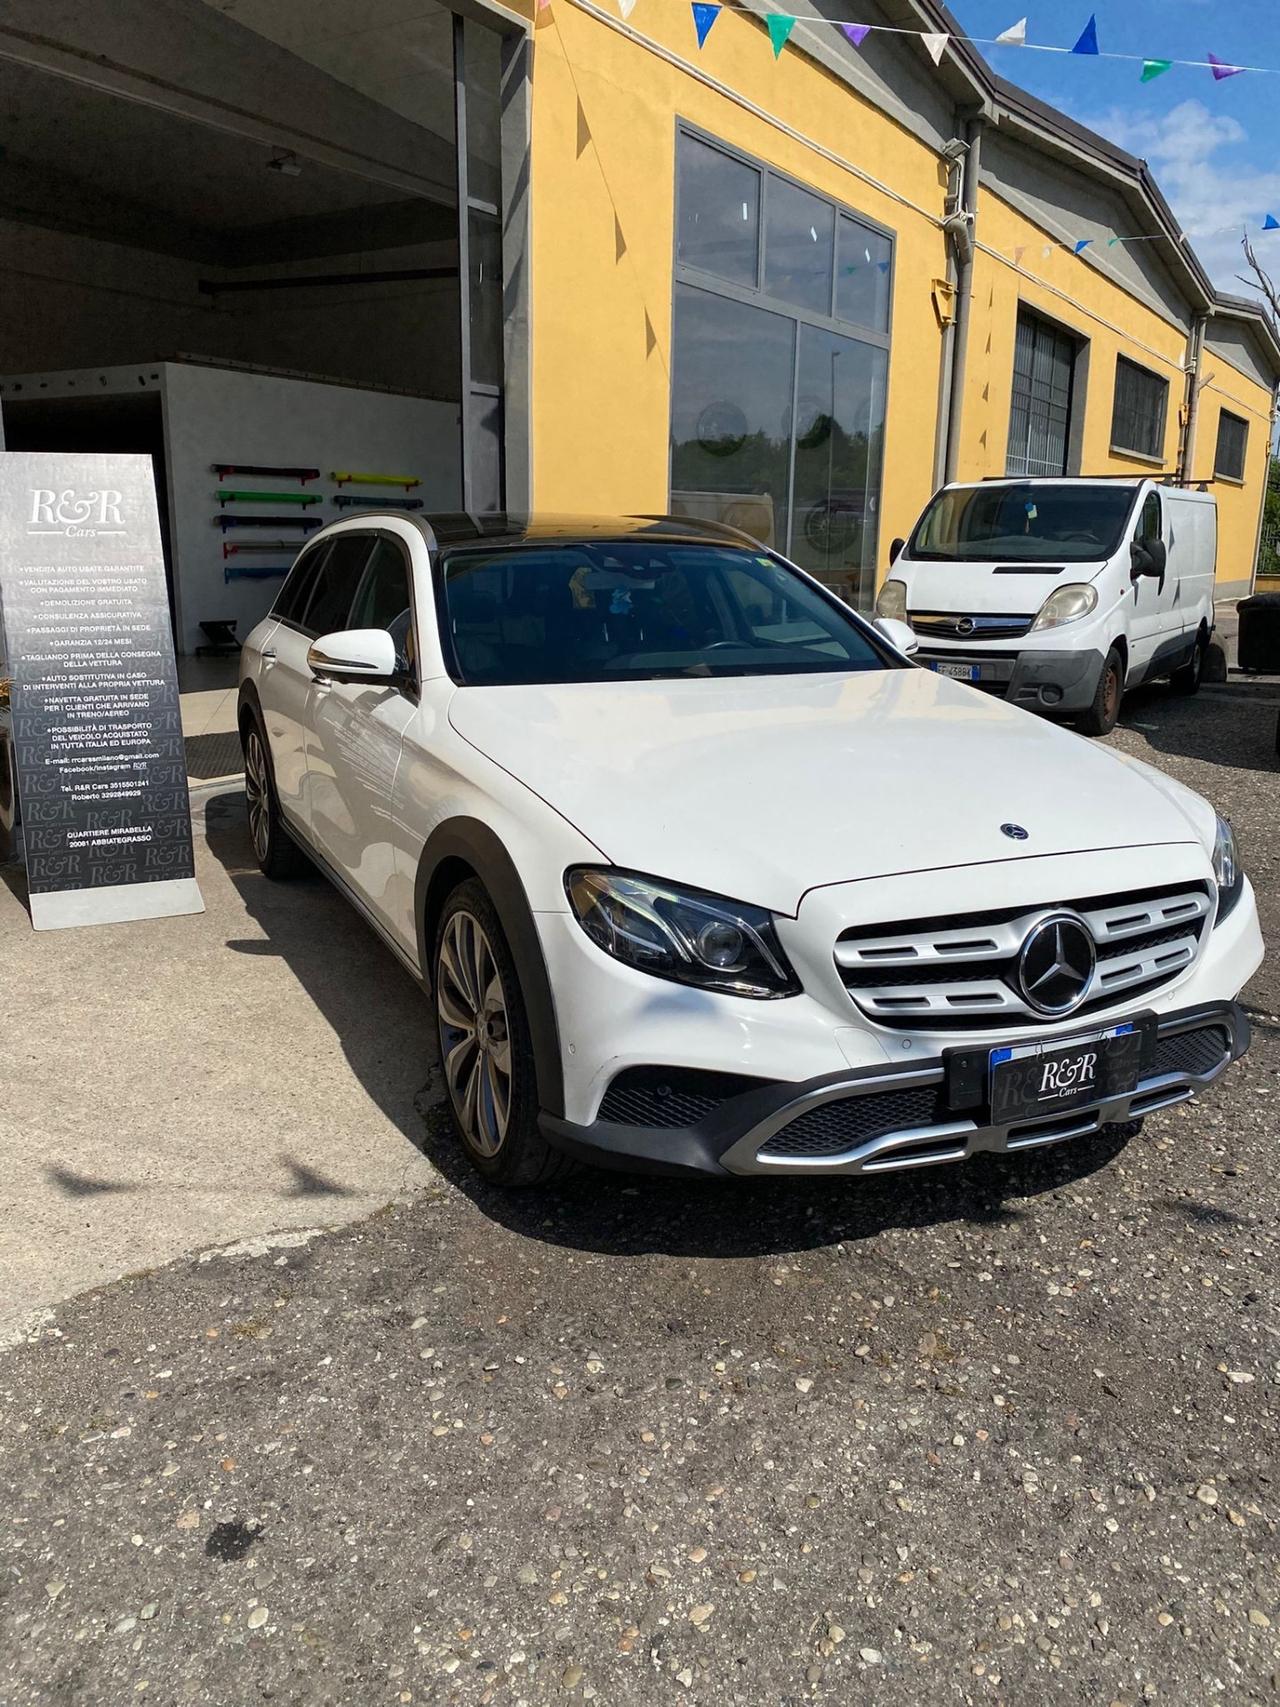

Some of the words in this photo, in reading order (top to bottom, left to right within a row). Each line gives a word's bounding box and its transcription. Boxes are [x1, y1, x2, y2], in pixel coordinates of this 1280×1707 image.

[27, 488, 126, 525] R&R
[65, 525, 97, 538] Cars
[57, 565, 78, 573] AUTO
[76, 578, 91, 586] DEL
[92, 578, 122, 586] VOSTRO
[123, 577, 148, 585] USATO
[49, 586, 96, 594] PAGAMENTO
[44, 599, 96, 607] DEMOLIZIONE
[97, 598, 133, 606] GRATUITA
[38, 612, 90, 620] CONSULENZA
[90, 611, 142, 619] ASSICURATIVA
[31, 626, 68, 634] PASSAGGI
[79, 623, 122, 633] PROPRIETÀ
[131, 624, 152, 632] SEDE
[54, 639, 93, 647] GARANZIA
[113, 638, 132, 646] MESI
[26, 653, 69, 661] TAGLIANDO
[70, 652, 95, 661] PRIMA
[96, 651, 120, 660] DELLA
[121, 650, 162, 659] CONSEGNA
[63, 660, 88, 668] DELLA
[88, 659, 123, 668] VETTURA
[46, 674, 68, 682] AUTO
[69, 672, 116, 682] SOSTITUTIVA
[116, 672, 125, 680] IN
[126, 671, 148, 680] CASO
[23, 683, 31, 691] DI
[32, 682, 77, 691] INTERVENTI
[78, 681, 98, 690] ALLA
[98, 680, 131, 689] PROPRIA
[131, 678, 166, 687] VETTURA
[48, 695, 82, 704] NAVETTA
[83, 694, 119, 702] GRATUITA
[119, 693, 129, 701] IN
[129, 693, 150, 701] SEDE
[44, 704, 61, 712] PER
[65, 702, 95, 712] CLIENTI
[95, 702, 112, 710] CHE
[112, 701, 150, 709] ARRIVANO
[66, 711, 76, 719] IN
[76, 709, 130, 719] TRENO/AEREO
[51, 723, 98, 734] POSSIBILITÀ
[98, 725, 108, 733] DI
[107, 722, 153, 731] TRASPORTO
[52, 734, 68, 742] DEL
[68, 733, 102, 742] VEICOLO
[102, 730, 149, 740] ACQUISTATO
[50, 743, 60, 751] IN
[60, 741, 85, 750] TUTTA
[85, 740, 109, 749] ITALIA
[109, 739, 120, 747] ED
[121, 738, 152, 747] EUROPA
[45, 757, 71, 766] E-mail:
[60, 784, 74, 793] Tel.
[74, 784, 91, 792] R&R
[91, 782, 109, 791] Cars
[71, 793, 100, 801] Roberto
[67, 829, 110, 839] QUARTIERE
[110, 826, 153, 836] MIRABELLA
[91, 834, 153, 847] ABBIATEGRASSO
[145, 845, 190, 867] R&R
[32, 855, 82, 879] R&R
[1038, 1052, 1098, 1093] R&R
[1058, 1086, 1078, 1098] Cars
